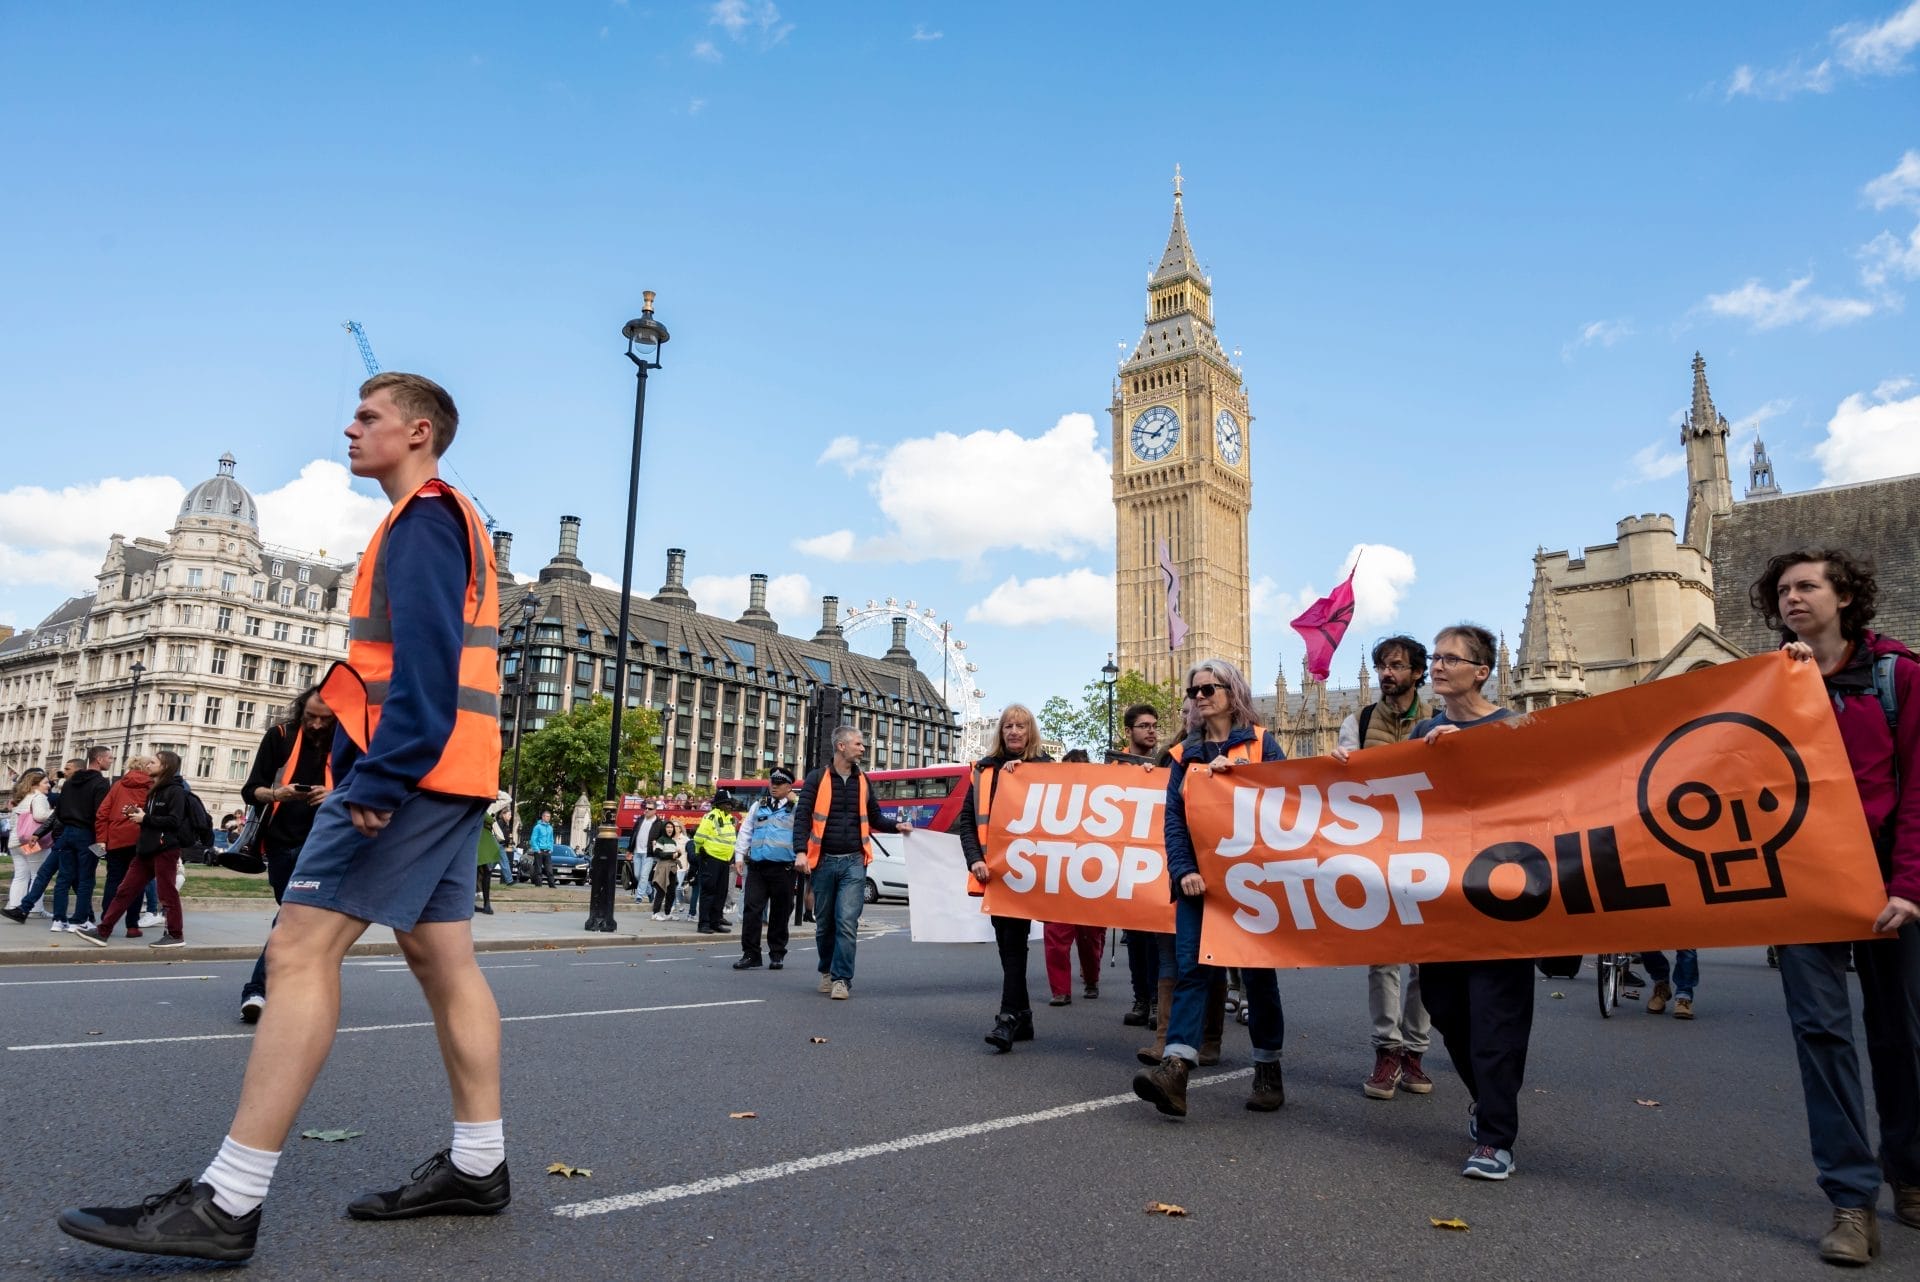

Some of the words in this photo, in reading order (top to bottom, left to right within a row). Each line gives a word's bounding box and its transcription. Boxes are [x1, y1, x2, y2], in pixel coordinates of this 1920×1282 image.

[1006, 783, 1168, 839] JUST
[1215, 772, 1433, 858] JUST
[1002, 837, 1164, 900] STOP
[1224, 851, 1451, 935] STOP
[1462, 826, 1671, 923] OIL
